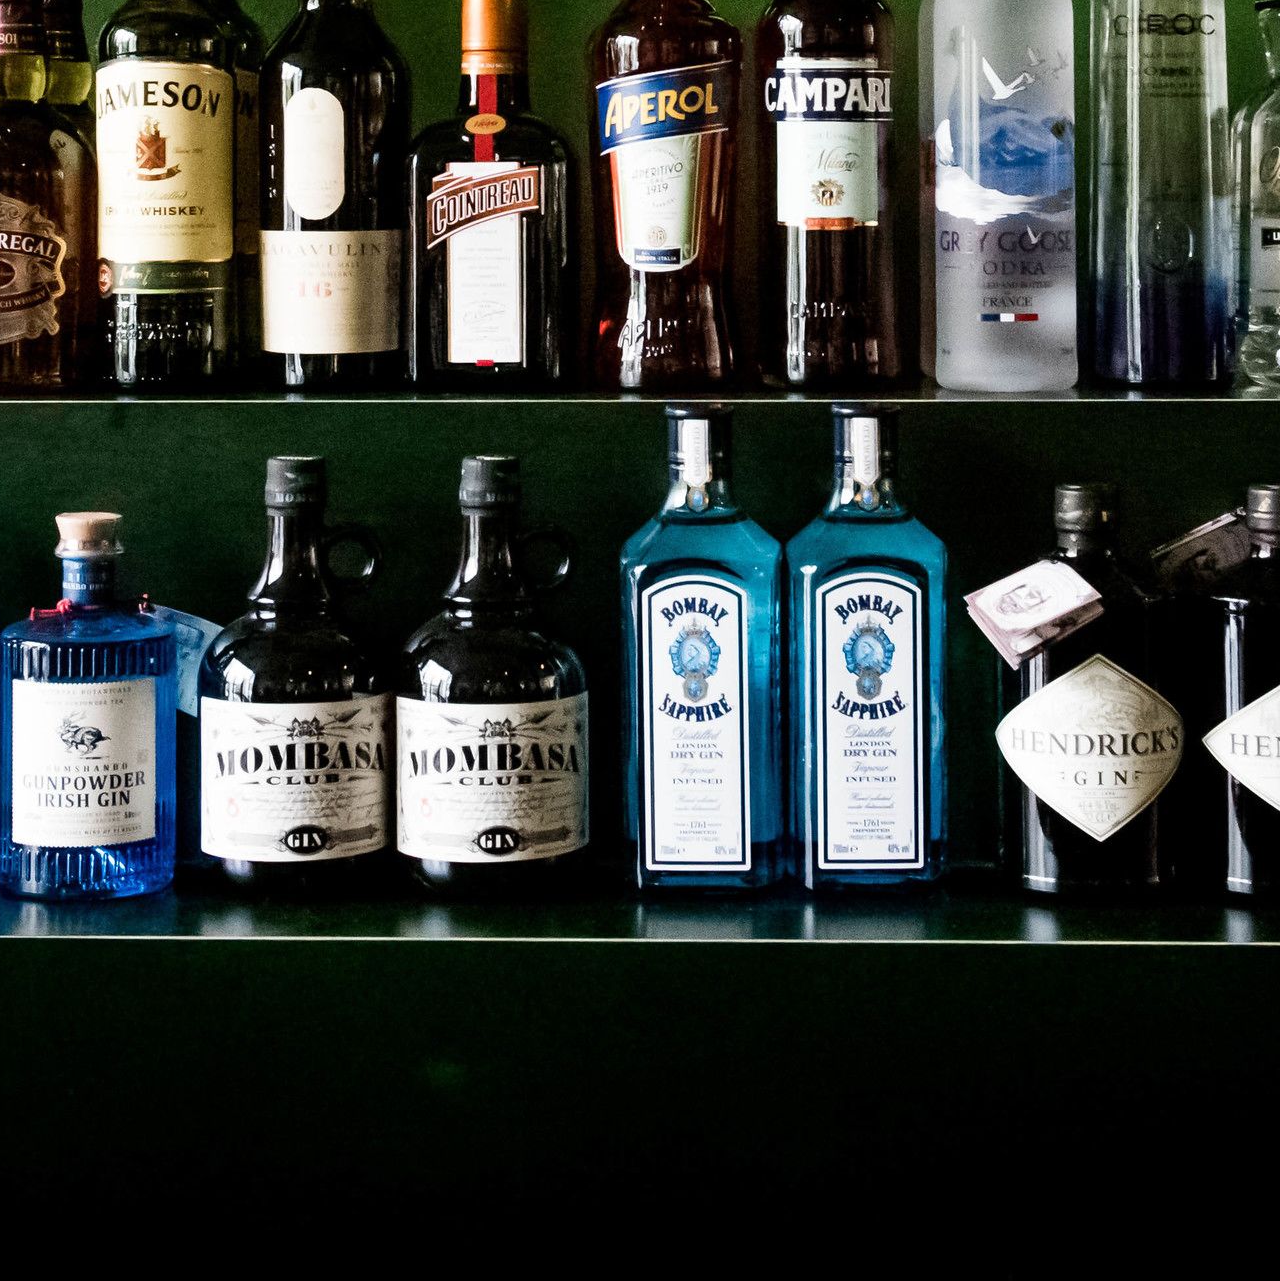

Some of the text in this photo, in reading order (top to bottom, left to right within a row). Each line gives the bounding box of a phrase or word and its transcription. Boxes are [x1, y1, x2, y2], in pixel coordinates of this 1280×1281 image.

[1114, 10, 1216, 36] CROC
[97, 80, 221, 120] JAMESON
[764, 76, 893, 113] CAMPARI
[604, 82, 721, 139] APEROL
[140, 206, 205, 216] WHISKEY
[431, 175, 535, 236] COINTREAU
[998, 229, 1072, 254] GOOSE
[974, 260, 1047, 276] ODKA
[982, 296, 1034, 308] FRANCE
[660, 597, 729, 627] BOMBAY
[834, 594, 904, 625] BOMBAY
[658, 693, 733, 722] SAPPHIRE
[831, 690, 906, 720] SAPPHIRE
[843, 749, 898, 757] DRY GIN
[1011, 726, 1180, 757] HENDRICK'S
[215, 741, 385, 779] MOMBASA
[409, 742, 580, 779] MOMBASA
[670, 751, 724, 759] DRY GIN
[45, 762, 128, 773] UMSHANBO
[1073, 770, 1129, 786] GIN
[22, 770, 146, 792] GUNPOWDER
[266, 774, 340, 785] CLUB
[459, 774, 534, 786] CLUB
[37, 790, 131, 808] IRISH GIN
[287, 832, 324, 848] GIN
[478, 833, 516, 849] GIN
